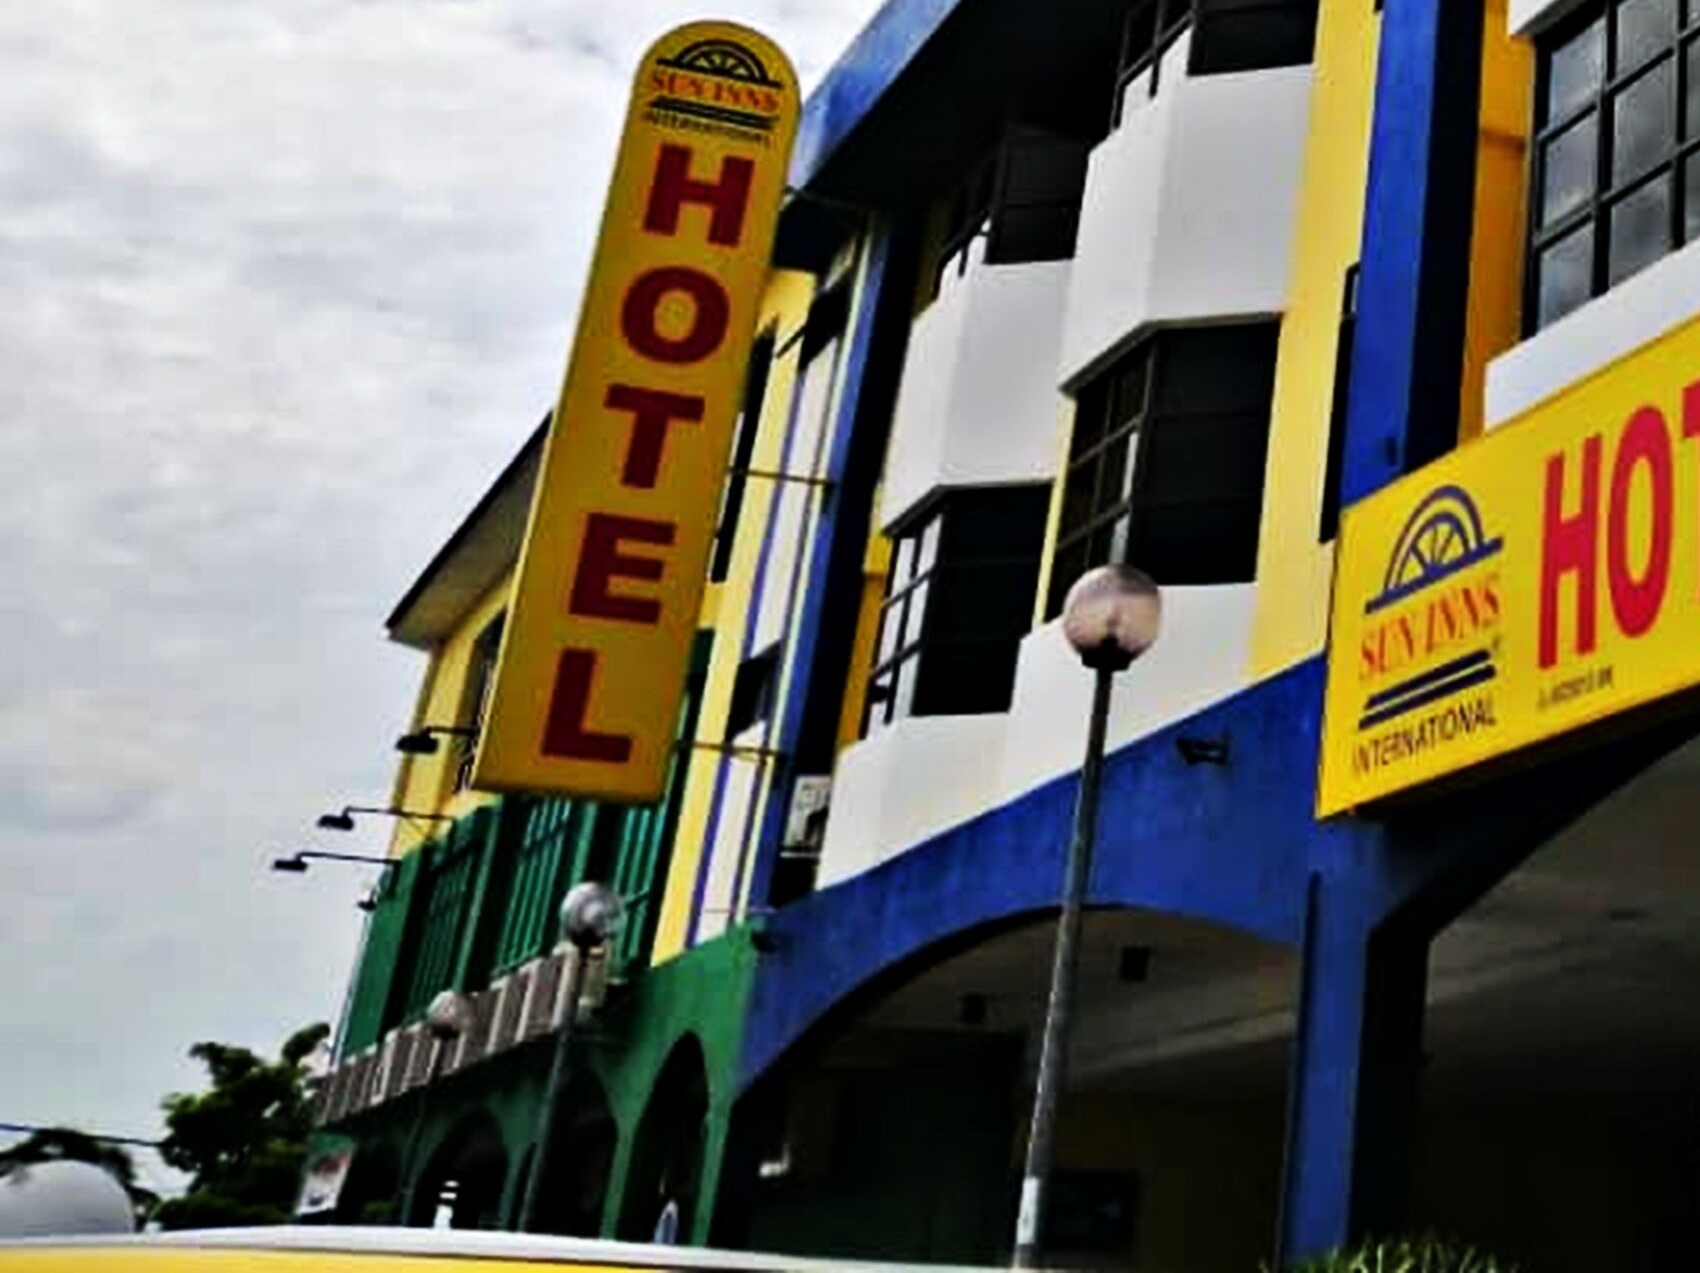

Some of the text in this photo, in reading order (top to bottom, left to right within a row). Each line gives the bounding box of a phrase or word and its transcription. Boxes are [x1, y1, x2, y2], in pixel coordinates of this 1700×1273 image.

[651, 67, 780, 112] SUN INNS
[541, 140, 758, 763] HOTEL
[1359, 574, 1499, 682] SUN INNS
[1354, 695, 1497, 776] INTERNATIONAL
